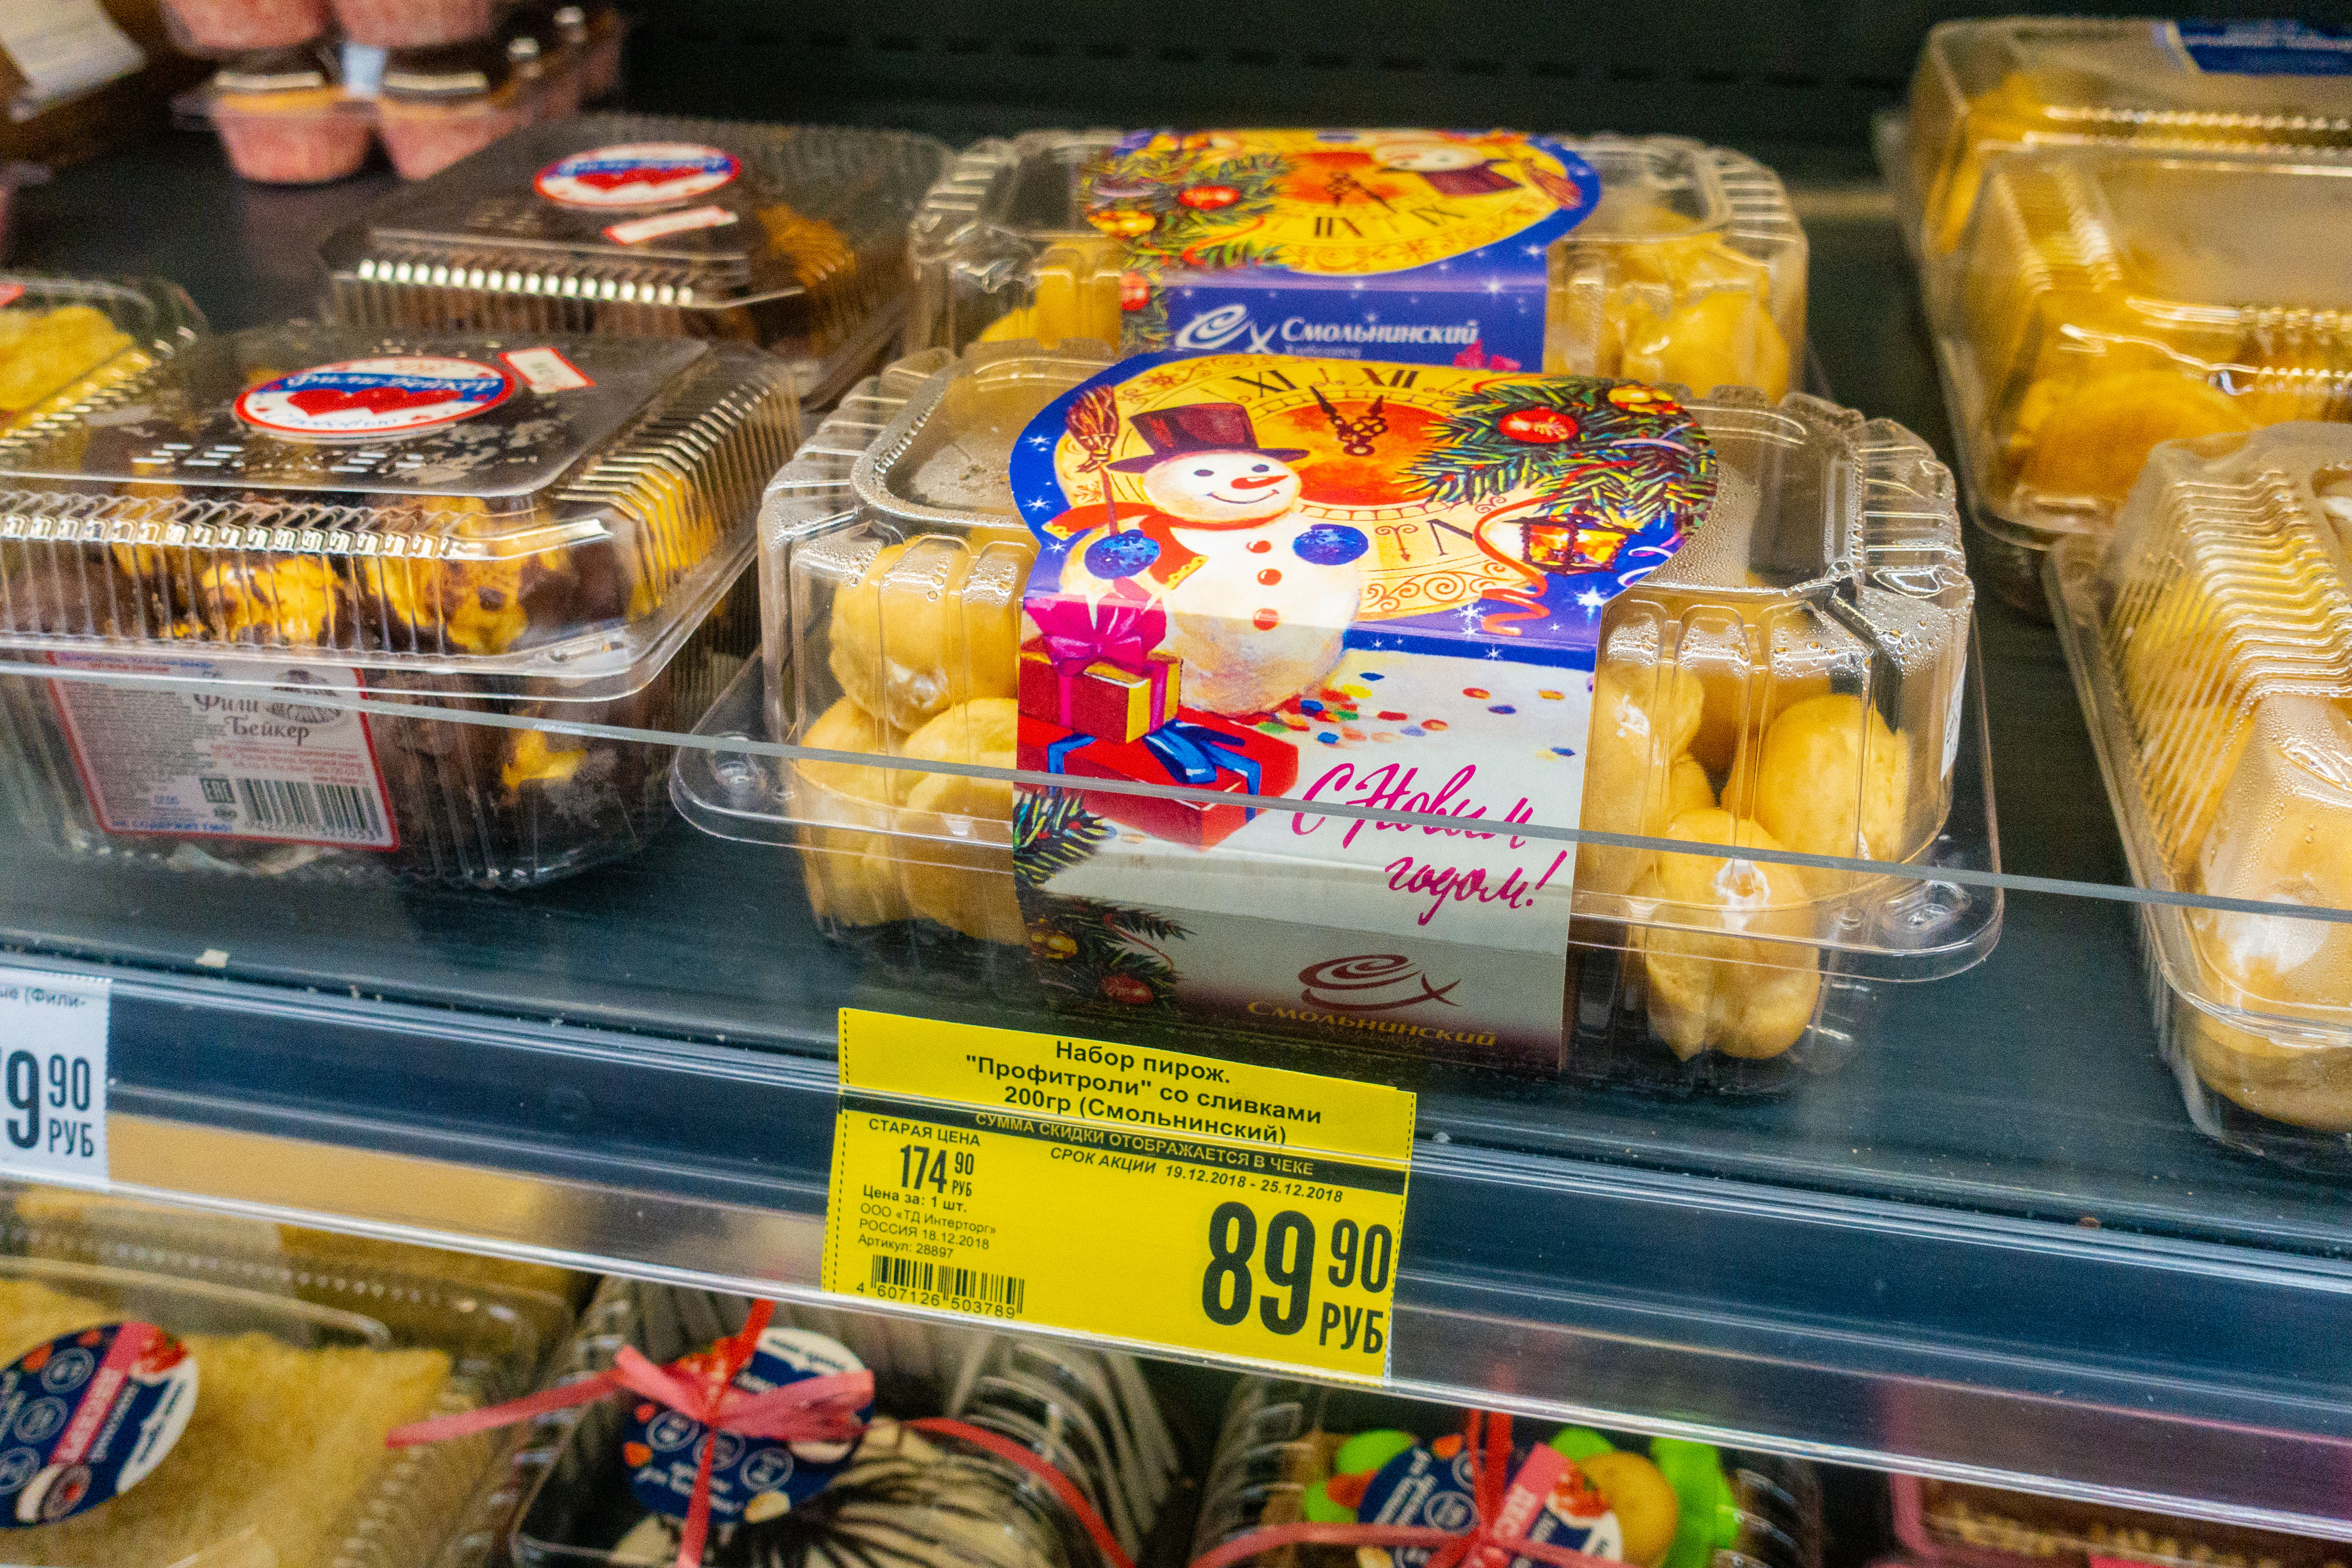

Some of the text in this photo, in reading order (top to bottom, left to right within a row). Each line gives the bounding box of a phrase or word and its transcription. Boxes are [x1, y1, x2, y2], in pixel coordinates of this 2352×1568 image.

[224, 715, 310, 746] Бейкер
[1292, 763, 1354, 836] С
[1385, 849, 1567, 926] годом!
[48, 1053, 91, 1112] 90
[1057, 1041, 1230, 1083] Набор пирож.
[966, 1054, 1322, 1124] "Профитроли" со сливками
[49, 1118, 94, 1158] РУБ
[869, 1118, 980, 1147] СТАРАЯ ЦЕНА
[1005, 1086, 1287, 1145] 200гр (Смольнинский)
[976, 1113, 1314, 1176] СУММА СКИДКИ ОТОБРАЖАЕТСЯ В ЧЕКЕ
[900, 1144, 974, 1194] 174 90
[952, 1180, 972, 1197] РУБ
[1051, 1148, 1096, 1165] СРОК
[1098, 1154, 1157, 1174] АКЦИИ
[1166, 1166, 1246, 1188] 19.12.2018
[1261, 1179, 1343, 1203] 25.12.2018
[860, 1202, 891, 1217] ООО
[863, 1184, 967, 1212] Цена за: 1 шт.
[858, 1234, 954, 1259] Артикул: 28897
[859, 1218, 989, 1250] РОССИЯ 18.12.2018
[1202, 1201, 1392, 1336] 89 90
[877, 1285, 940, 1307] 607126
[951, 1297, 1016, 1319] 503789
[1318, 1302, 1384, 1354] РУБ
